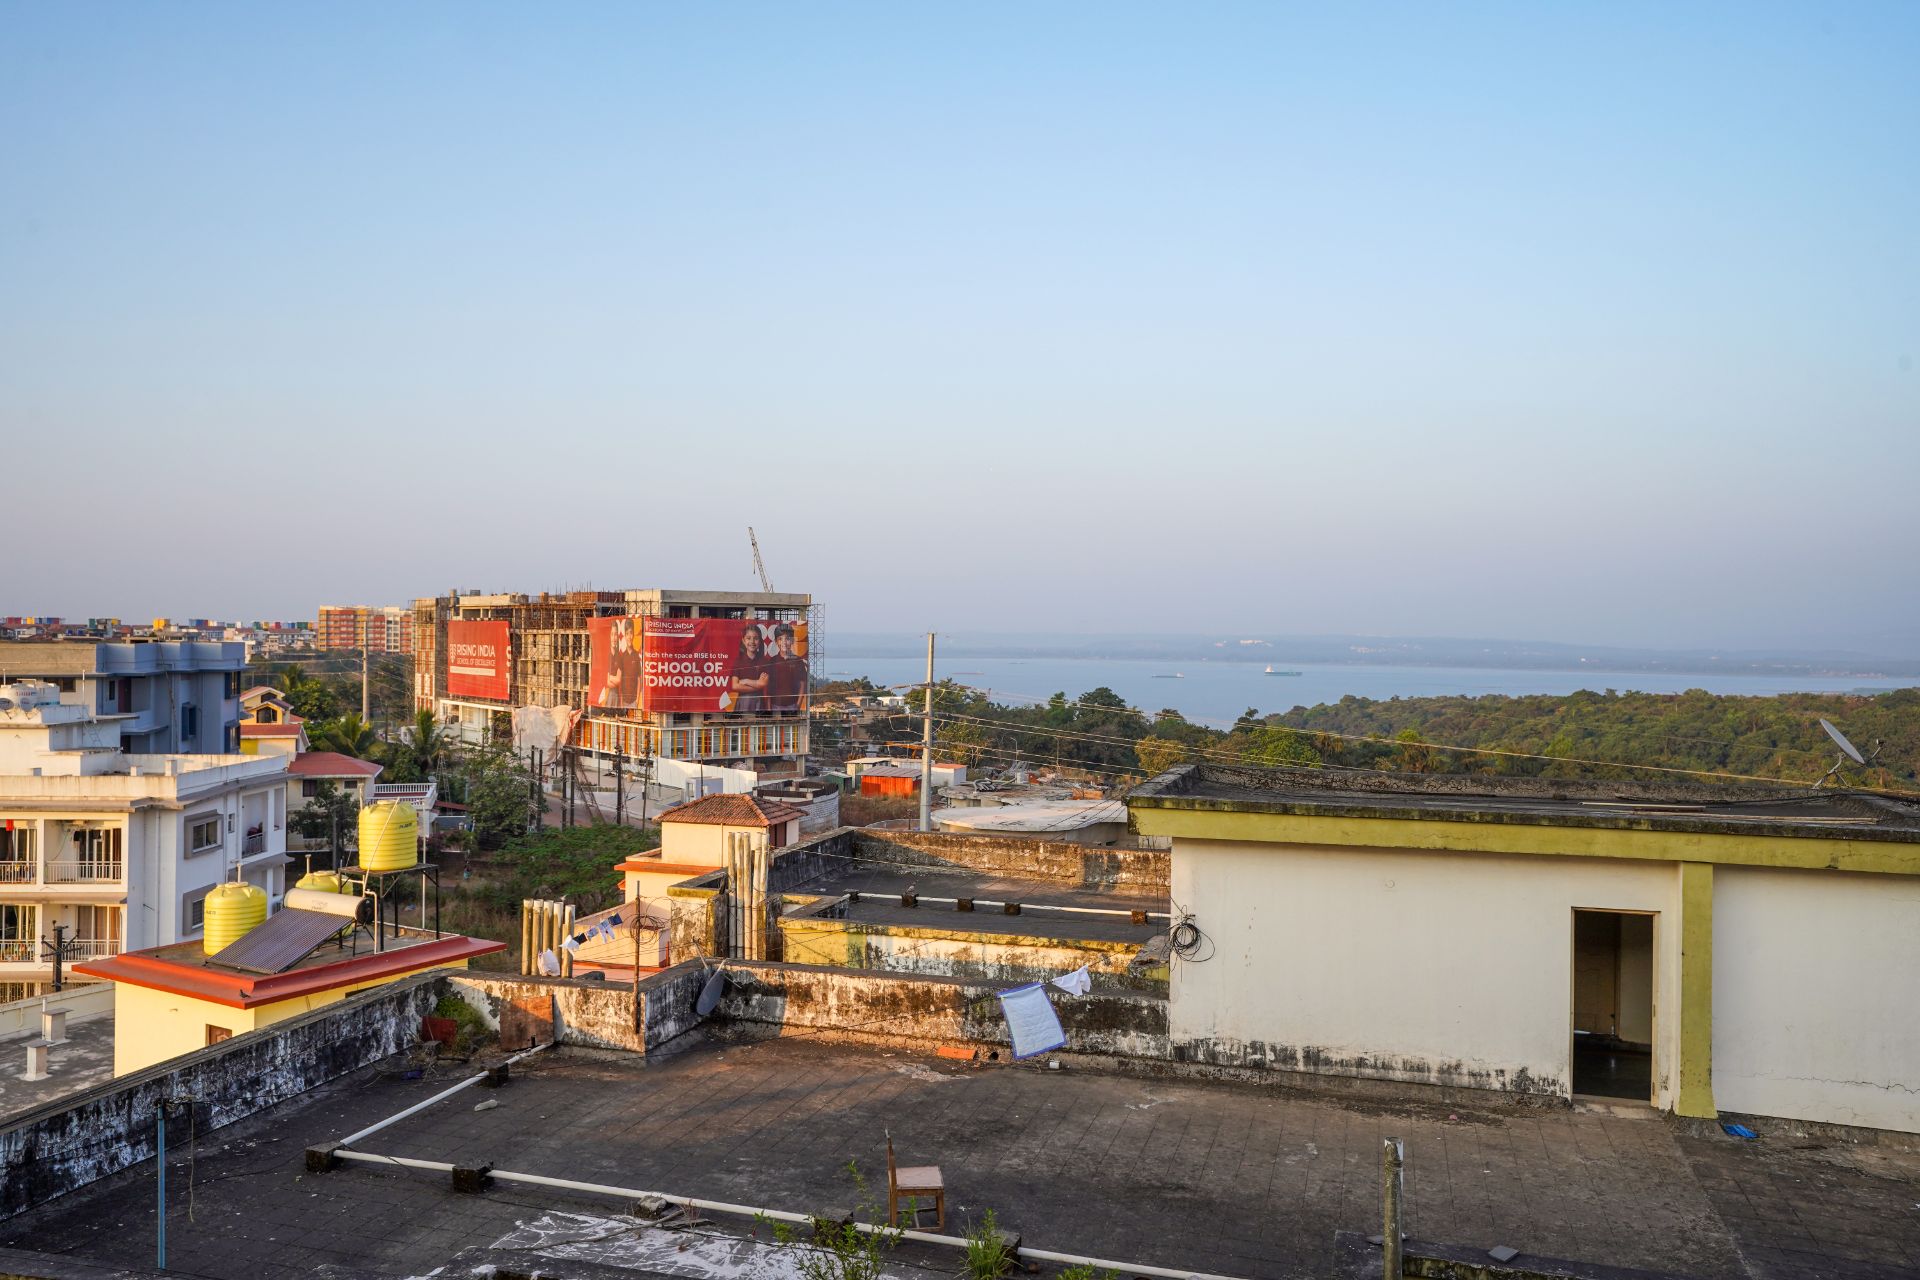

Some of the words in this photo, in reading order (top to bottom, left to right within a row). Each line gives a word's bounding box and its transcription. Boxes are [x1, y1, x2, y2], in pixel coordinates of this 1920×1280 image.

[648, 621, 673, 629] RISING
[456, 644, 477, 656] RISING
[477, 644, 496, 657] INDIA
[703, 661, 724, 674] OF
[645, 674, 730, 688] TOMORROW
